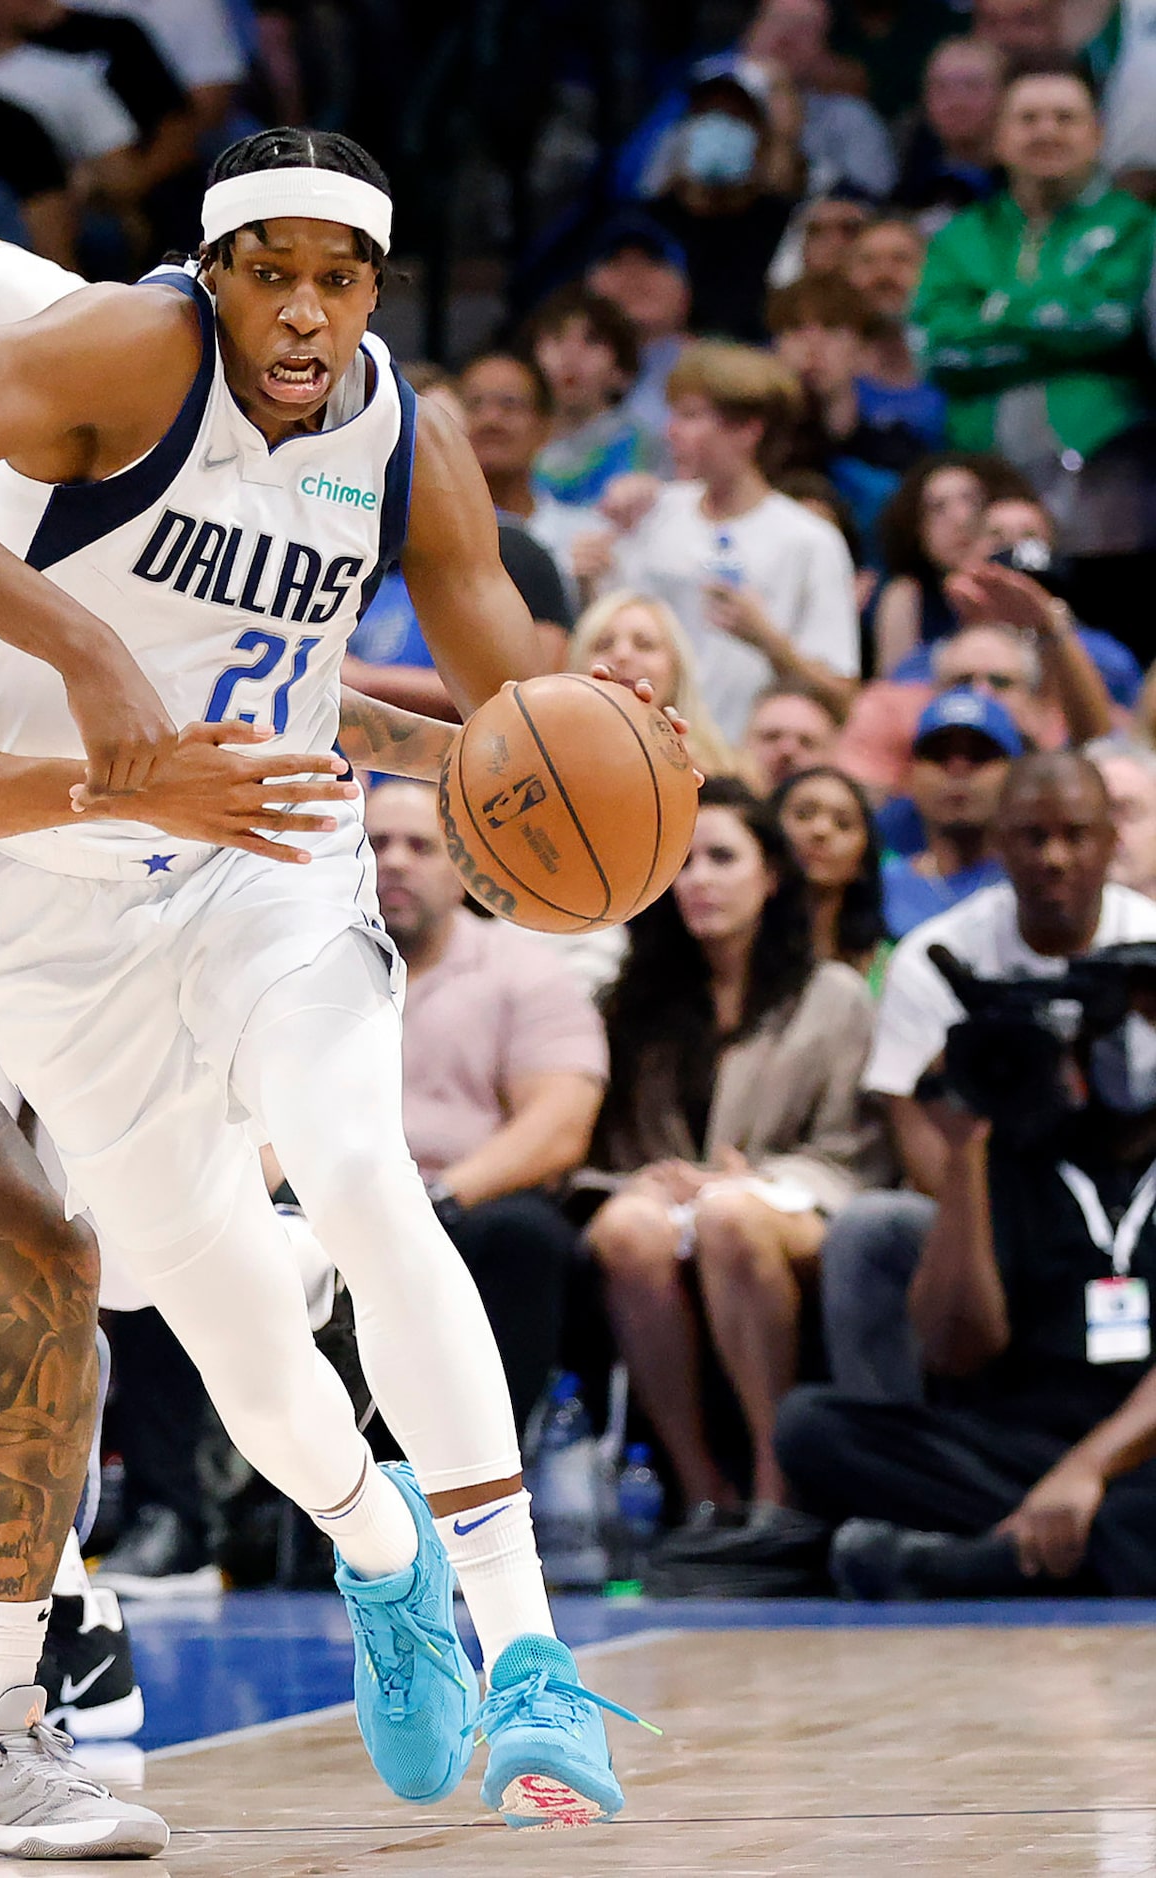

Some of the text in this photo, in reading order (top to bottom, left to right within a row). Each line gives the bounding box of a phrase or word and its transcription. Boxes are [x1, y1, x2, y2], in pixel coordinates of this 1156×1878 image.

[300, 472, 377, 511] chime
[131, 506, 365, 624] DALLAS
[203, 626, 325, 736] 21
